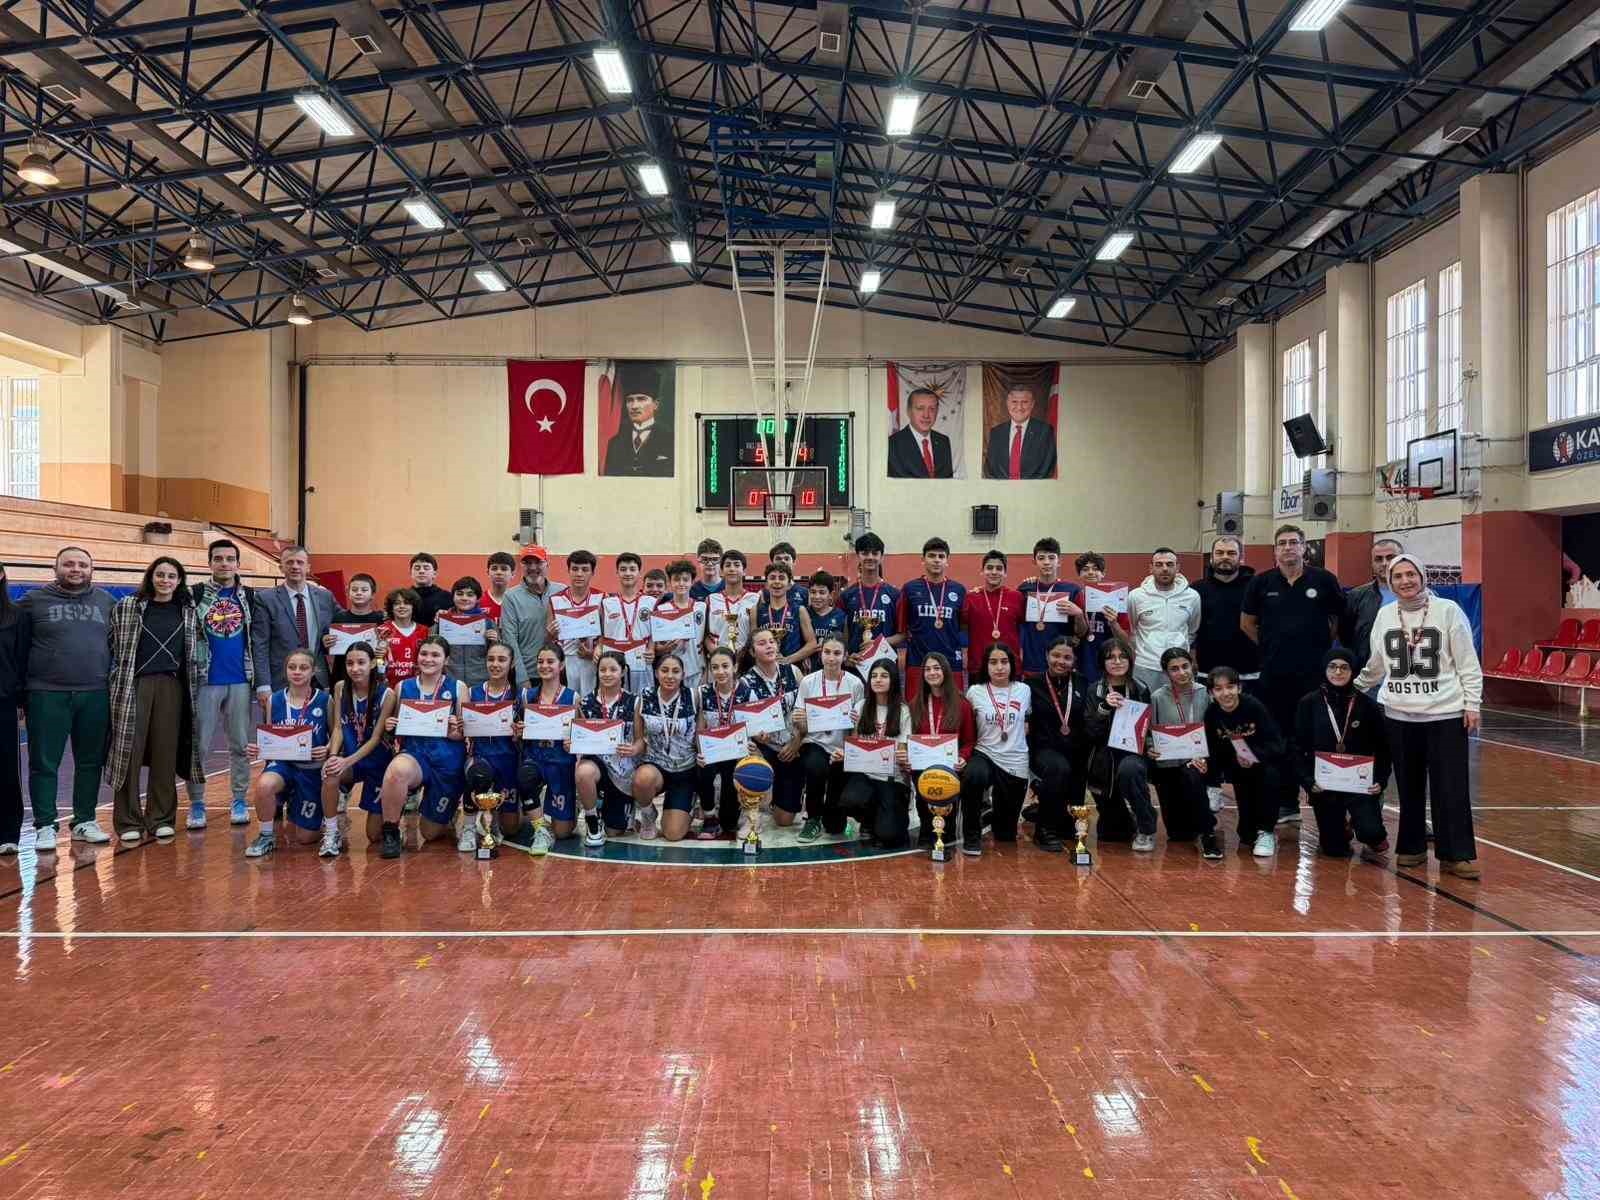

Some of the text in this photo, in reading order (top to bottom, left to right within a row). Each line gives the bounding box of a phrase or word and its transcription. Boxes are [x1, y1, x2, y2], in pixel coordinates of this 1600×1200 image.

[802, 491, 815, 505] 10
[404, 647, 411, 659] 2
[1383, 627, 1442, 680] 93
[1387, 681, 1440, 694] BOSTON
[299, 800, 317, 818] 13
[436, 796, 449, 813] 9
